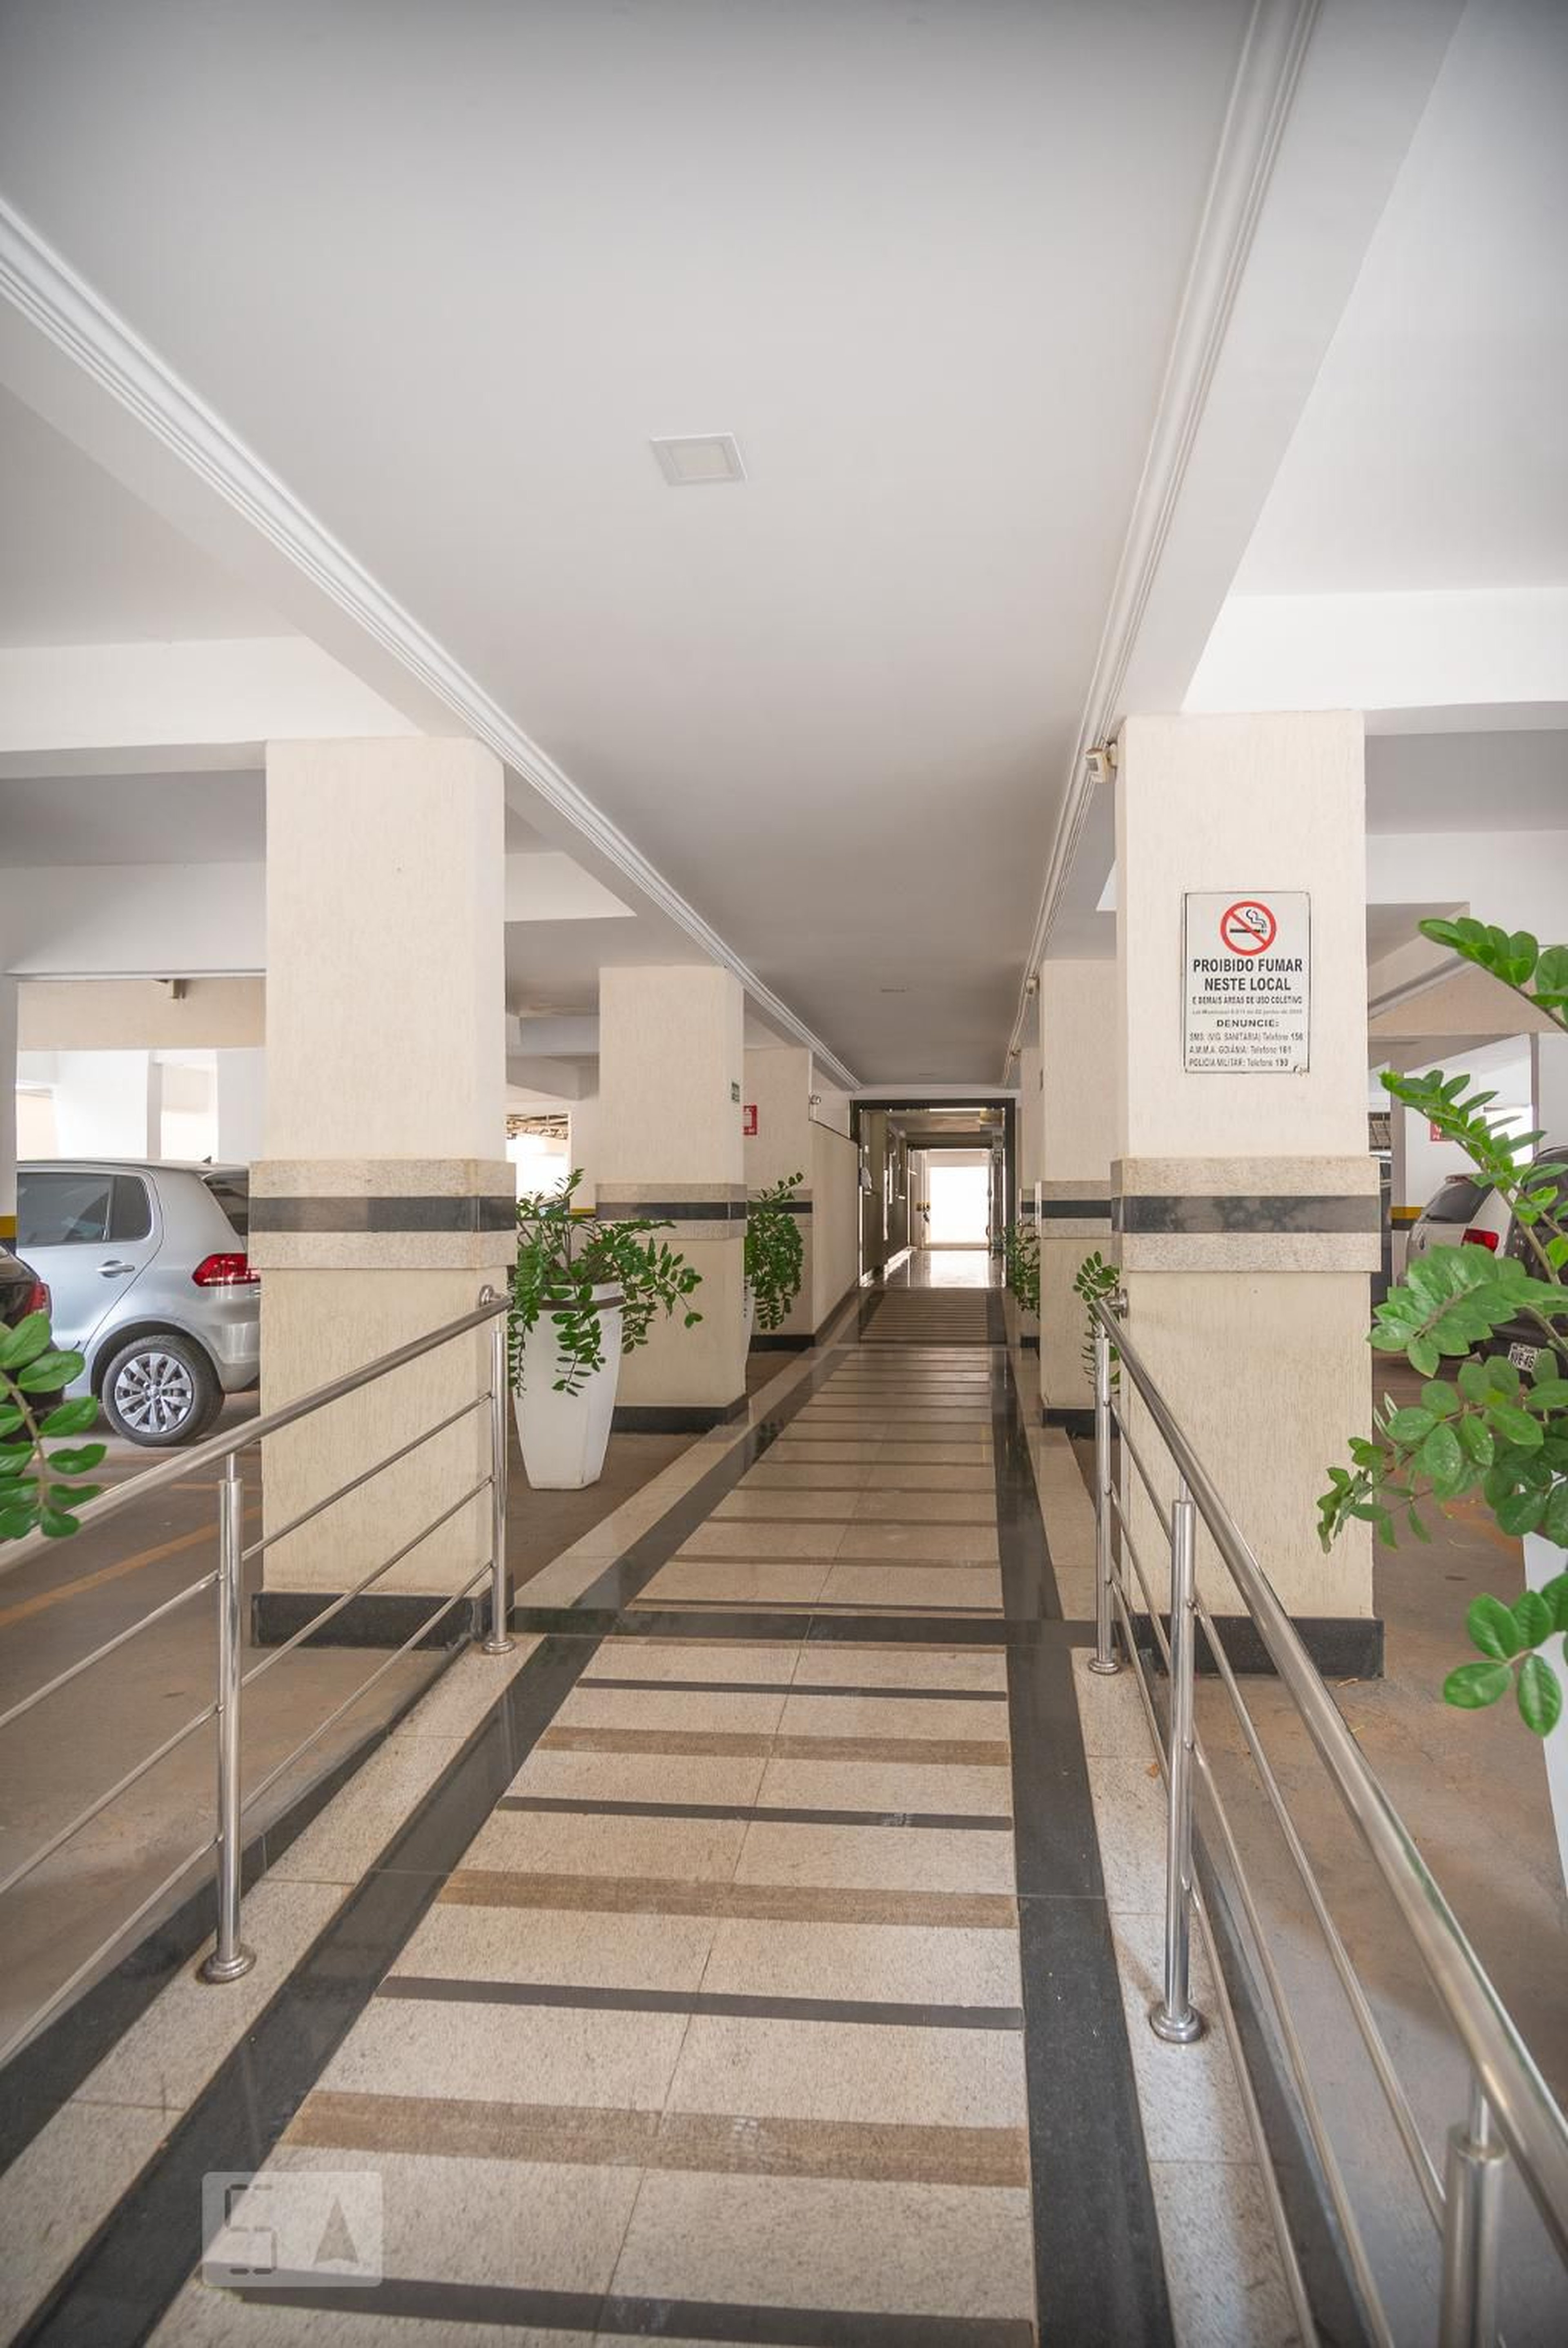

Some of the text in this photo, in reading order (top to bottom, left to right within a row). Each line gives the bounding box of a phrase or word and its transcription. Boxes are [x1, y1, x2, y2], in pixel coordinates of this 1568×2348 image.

[1193, 959, 1303, 972] PROIBIDO FUMAR
[1205, 978, 1292, 991] NESTE LOCAL
[1198, 996, 1222, 1004] DEMAIS
[1255, 996, 1270, 1004] USO
[1271, 996, 1302, 1004] COLETIVO
[1216, 1019, 1279, 1028] DENUNCIE:
